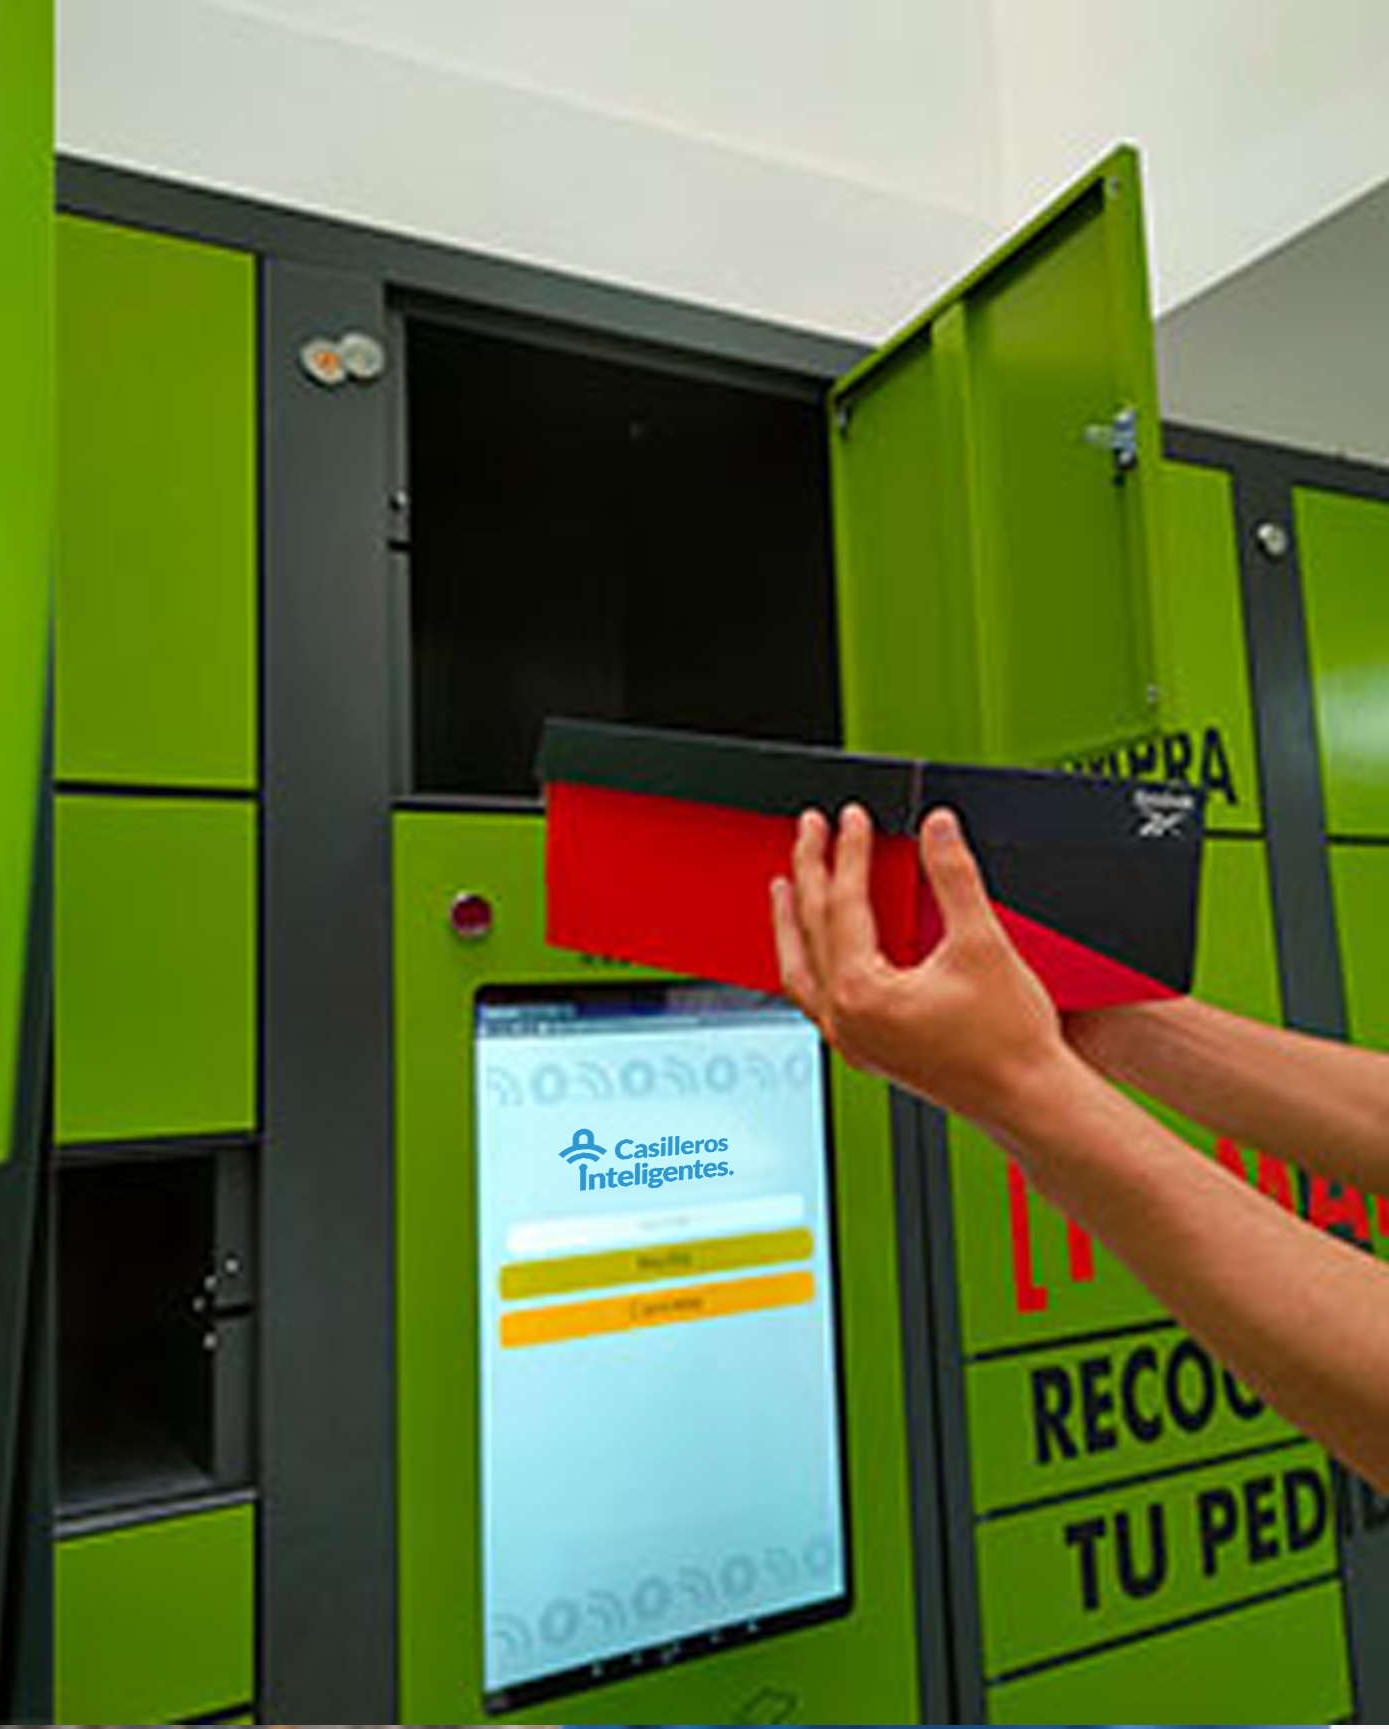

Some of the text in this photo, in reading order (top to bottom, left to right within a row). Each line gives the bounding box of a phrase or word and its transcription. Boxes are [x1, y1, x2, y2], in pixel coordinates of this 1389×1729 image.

[614, 1135, 730, 1161] Casilleros
[578, 1160, 735, 1192] Inteligentes.
[1064, 1503, 1168, 1612] TU
